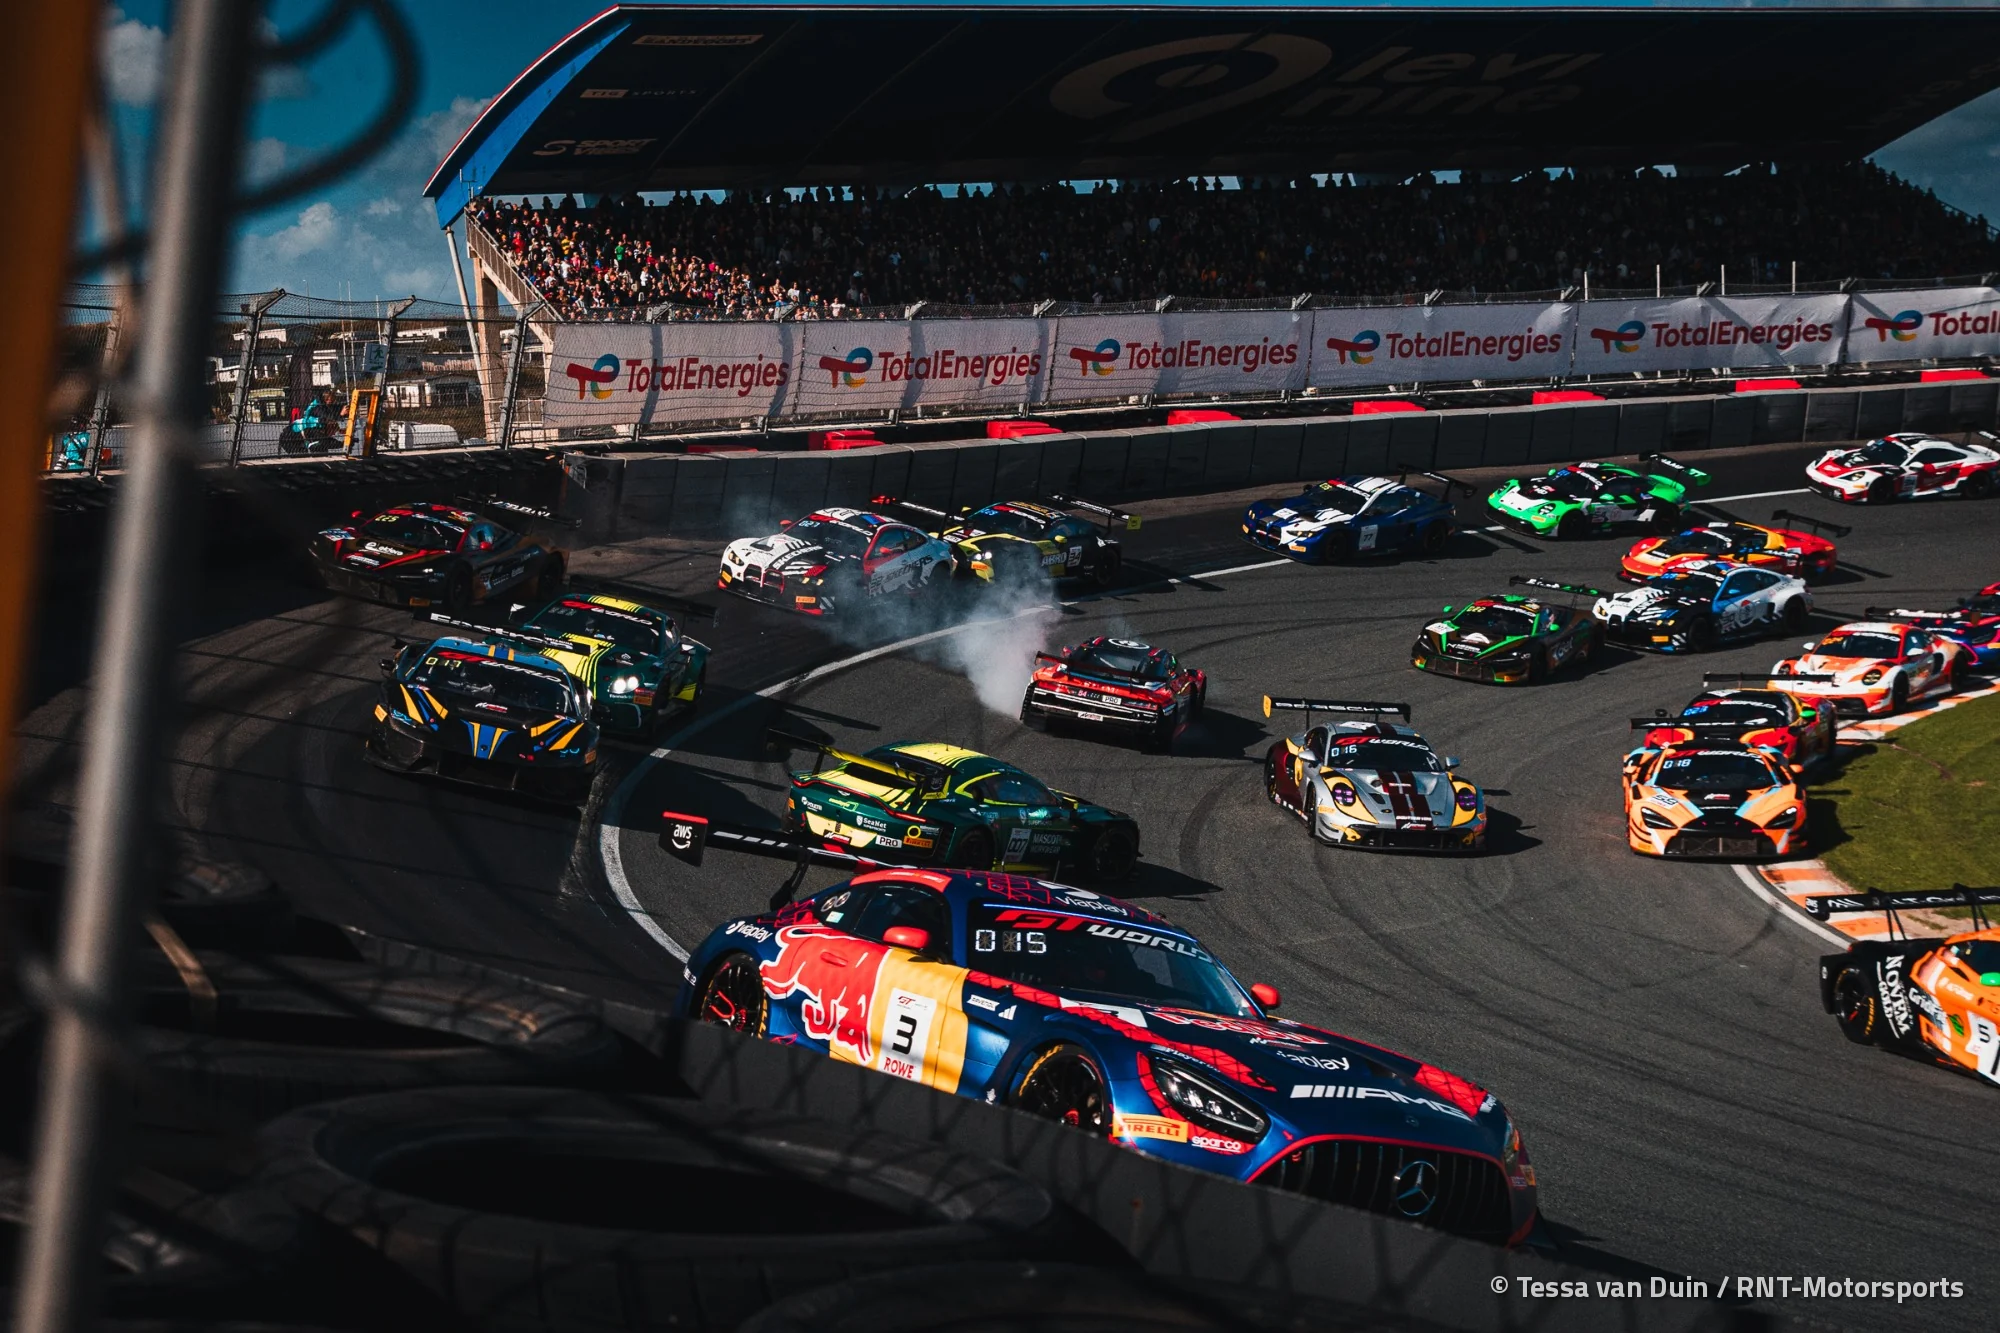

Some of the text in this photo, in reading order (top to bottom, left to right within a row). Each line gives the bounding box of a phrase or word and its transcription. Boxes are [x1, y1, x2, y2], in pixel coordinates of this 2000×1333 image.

[1334, 46, 1604, 83] levi
[1280, 85, 1583, 117] nine
[1651, 317, 1833, 351] TotalEnergies
[1928, 310, 2000, 336] Total
[1125, 336, 1297, 373] TotalEnergies
[1385, 327, 1563, 362] TotalEnergies
[625, 353, 790, 398] TotalEnergies
[878, 346, 1041, 386] TotalEnergies
[1363, 533, 1374, 542] 77
[1368, 737, 1430, 751] WORLD
[673, 824, 694, 839] aws
[863, 817, 888, 829] SeaNet
[879, 836, 899, 847] PRO
[1032, 834, 1061, 844] MASCOT
[994, 908, 1214, 964] GT WORLD
[892, 1015, 918, 1055] 3
[883, 1056, 915, 1080] ROWE
[1355, 1086, 1475, 1122] AMG
[1117, 1117, 1181, 1138] PIRELLI
[1191, 1135, 1242, 1151] sparco
